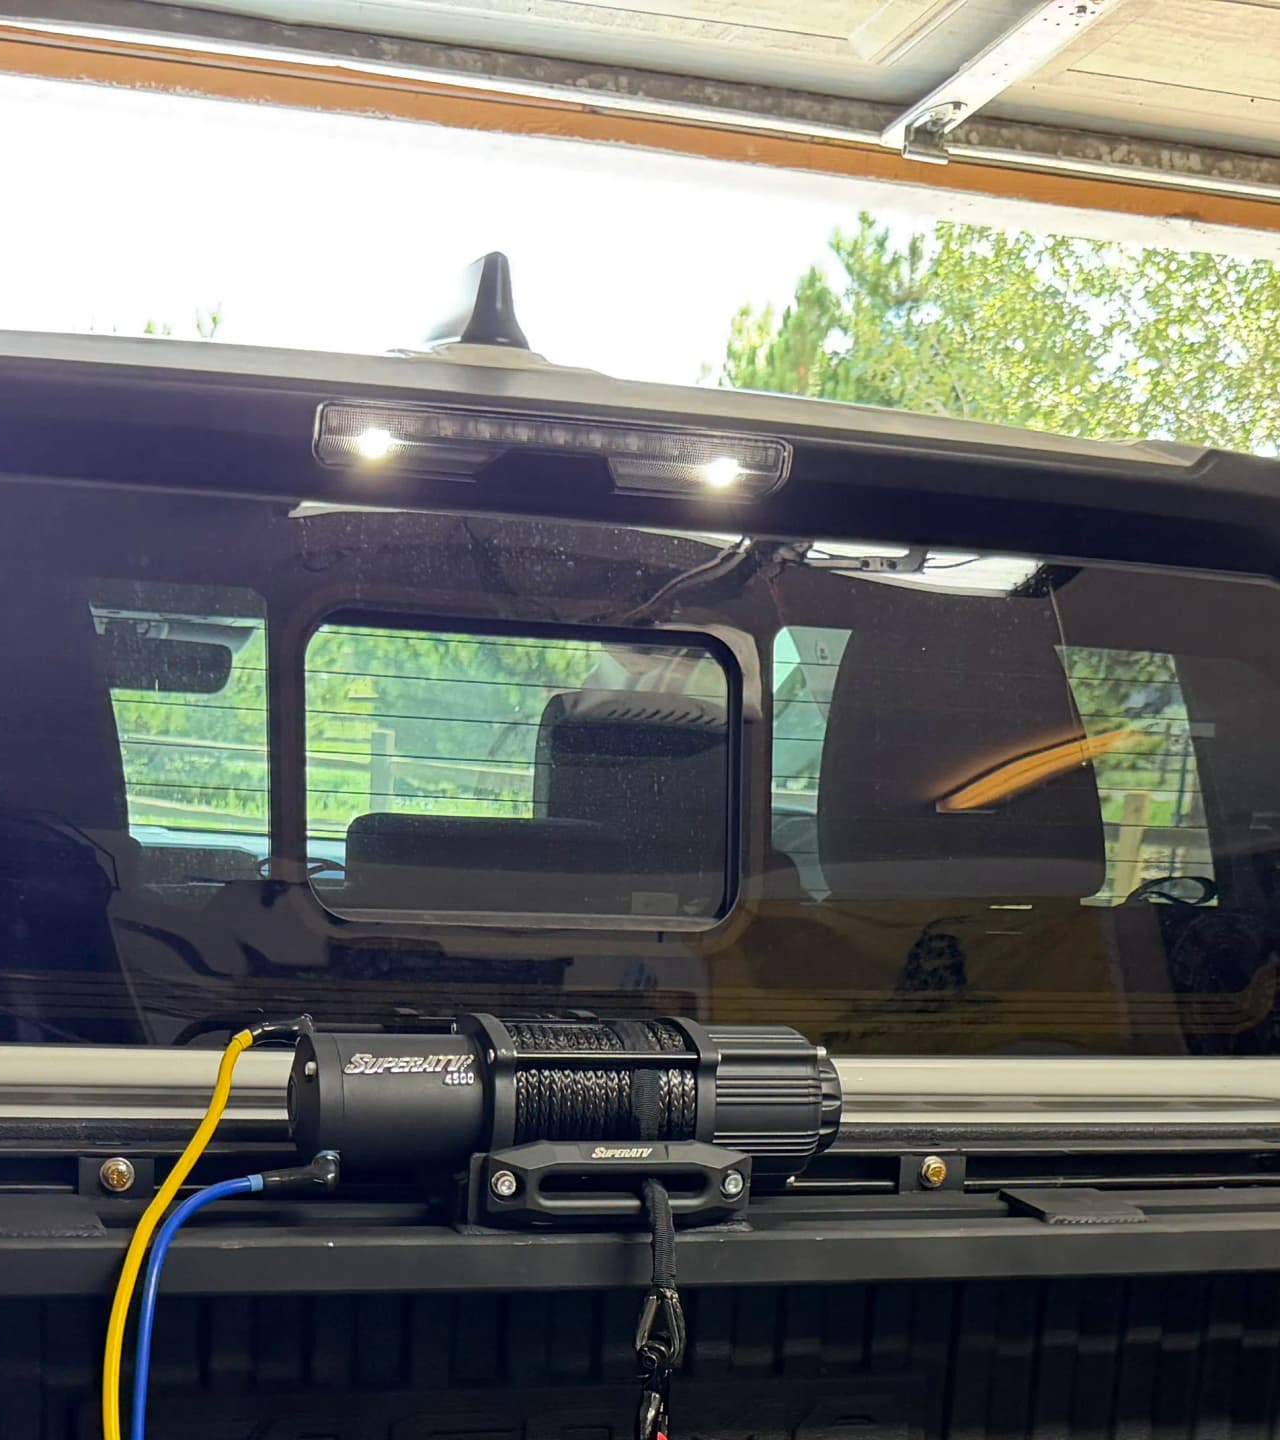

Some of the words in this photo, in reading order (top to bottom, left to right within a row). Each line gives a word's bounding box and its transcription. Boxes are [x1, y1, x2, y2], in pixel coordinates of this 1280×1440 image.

[343, 1053, 475, 1074] SUPERATV
[443, 1072, 475, 1086] 4500
[591, 1146, 653, 1159] SUPERATV
